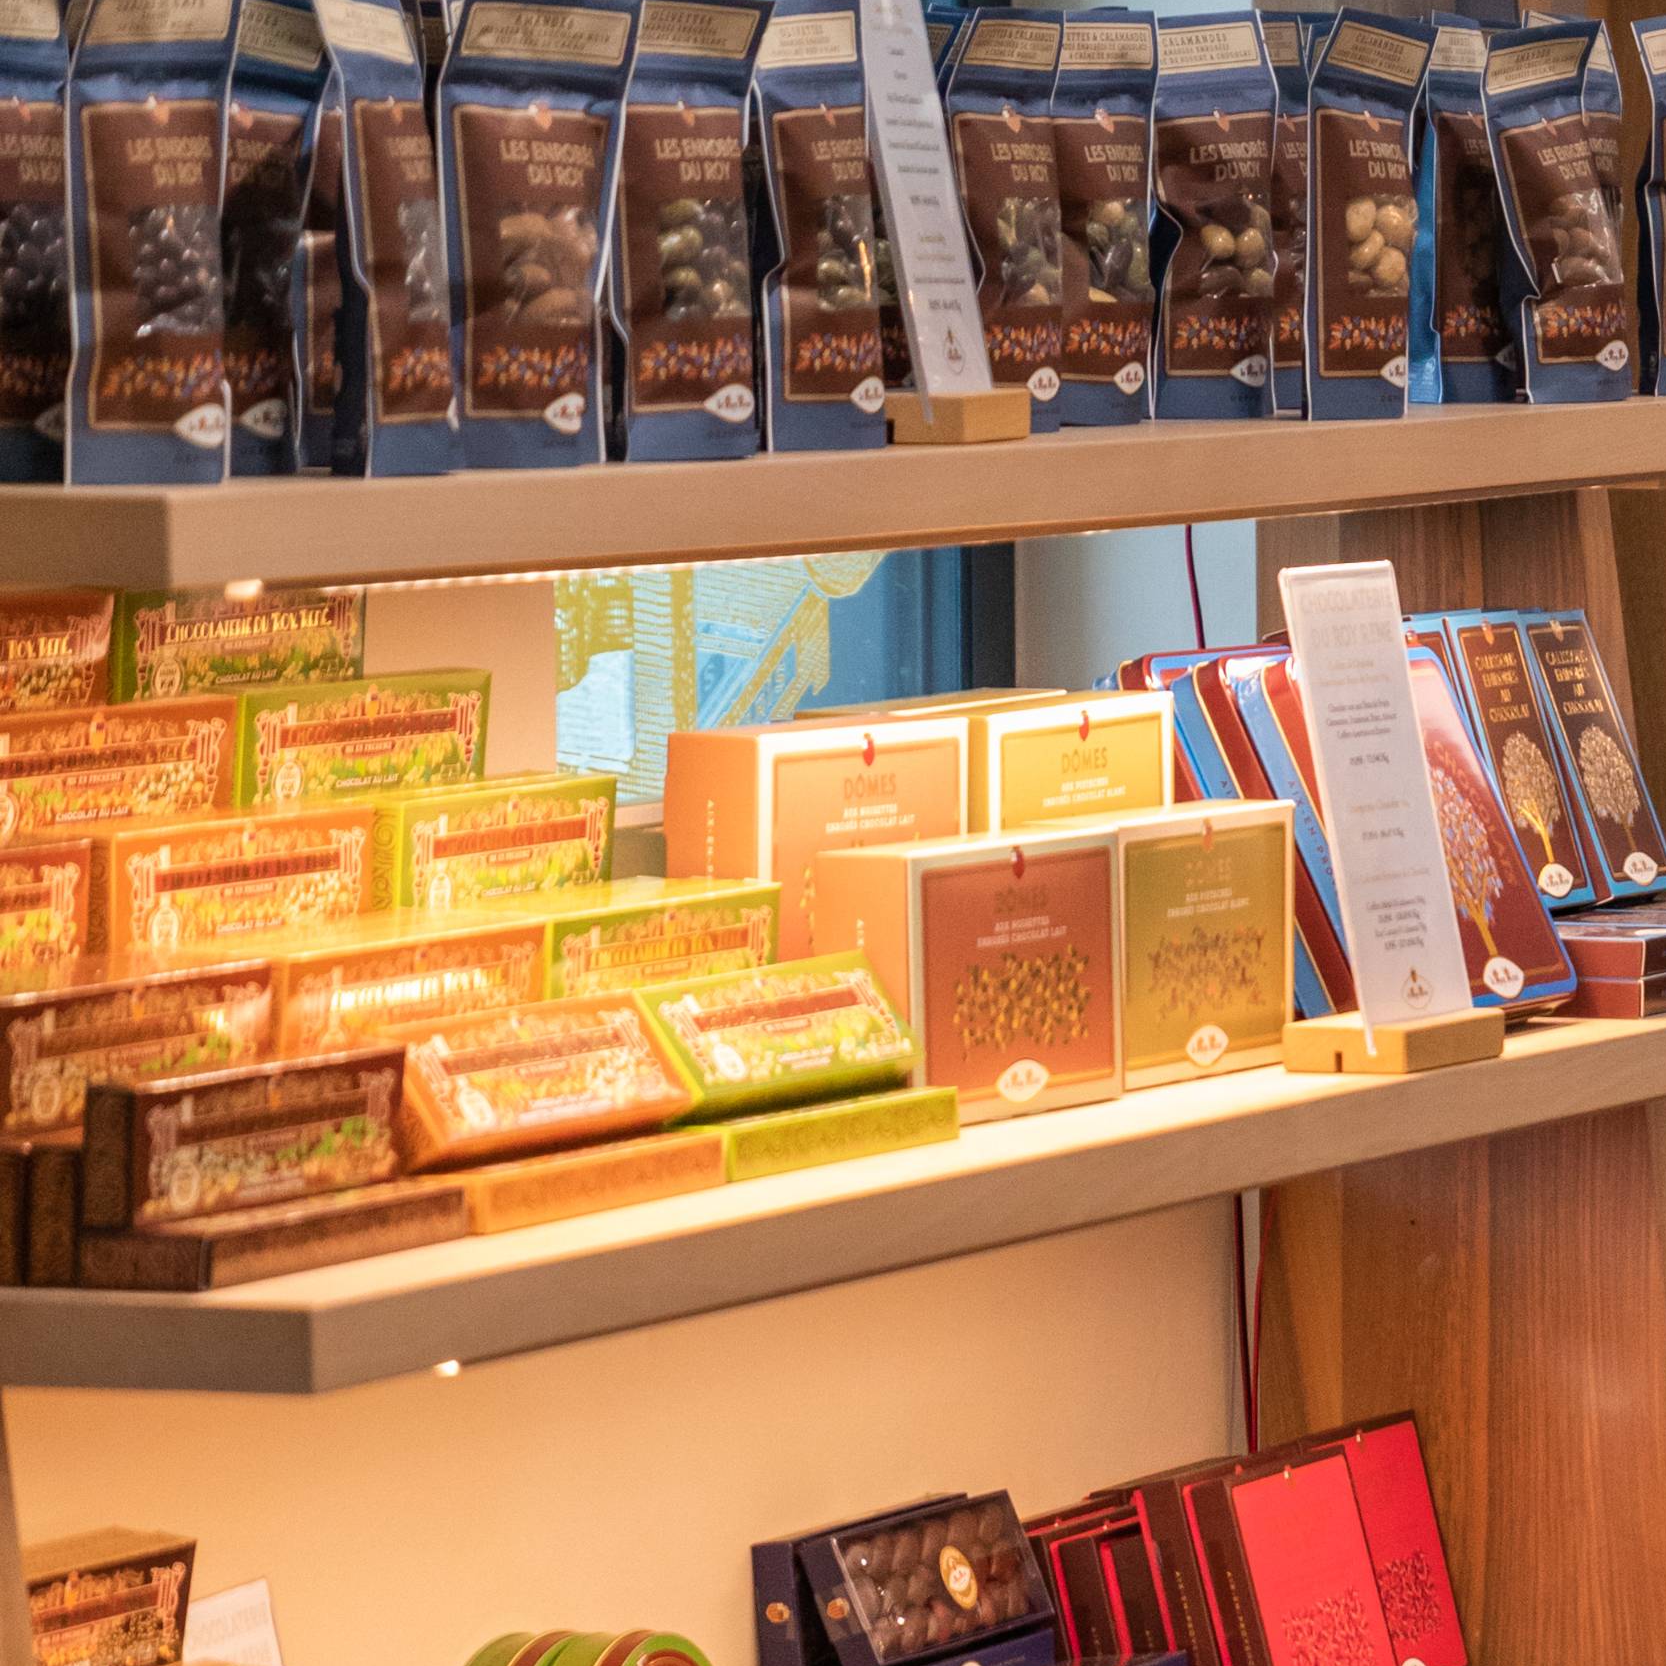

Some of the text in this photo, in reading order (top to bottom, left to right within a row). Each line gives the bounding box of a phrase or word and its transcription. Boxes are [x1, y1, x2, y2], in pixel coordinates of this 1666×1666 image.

[1162, 32, 1228, 47] CALAMANDES
[501, 140, 530, 162] LES
[655, 138, 680, 160] LES
[990, 143, 1013, 162] LES
[1084, 145, 1106, 163] LES
[1190, 138, 1268, 165] LES ENROBÉS
[1349, 140, 1369, 157] LES
[1537, 148, 1558, 167] LES
[527, 163, 585, 187] DU ROY
[679, 160, 731, 181] DU ROY
[1011, 163, 1049, 182] DU ROY
[1107, 164, 1140, 182] DU ROY
[1215, 159, 1262, 182] DU ROY
[1368, 159, 1407, 179] DU ROY
[1558, 162, 1578, 180] DU
[1300, 587, 1394, 613] CHOCOLATERIE
[166, 615, 253, 644] CHOCOLATERIE
[252, 611, 270, 634] DU
[271, 608, 299, 633] ROY
[214, 668, 279, 686] CHOCOLAT AU LAIT
[1499, 687, 1513, 703] AU
[1572, 682, 1586, 698] AU
[1488, 703, 1530, 724] CHOCOLAT
[1562, 697, 1605, 717] CHOCOLAT
[1061, 746, 1109, 775] DÔMES
[335, 773, 401, 789] CHOCOLAT AU LAIT
[843, 772, 897, 800] DÔMES
[1071, 788, 1106, 803] CHOCOLAT
[55, 805, 130, 823] CHOCOLAT AU LAIT
[859, 803, 898, 817] NOISETTES
[858, 815, 898, 830] CHOCOLAT
[898, 813, 916, 826] LAIT
[1198, 899, 1230, 914] CHOCOLAT
[216, 919, 253, 934] CHOCOLAT
[1010, 927, 1050, 944] CHOCOLAT
[1050, 925, 1068, 938] LAIT
